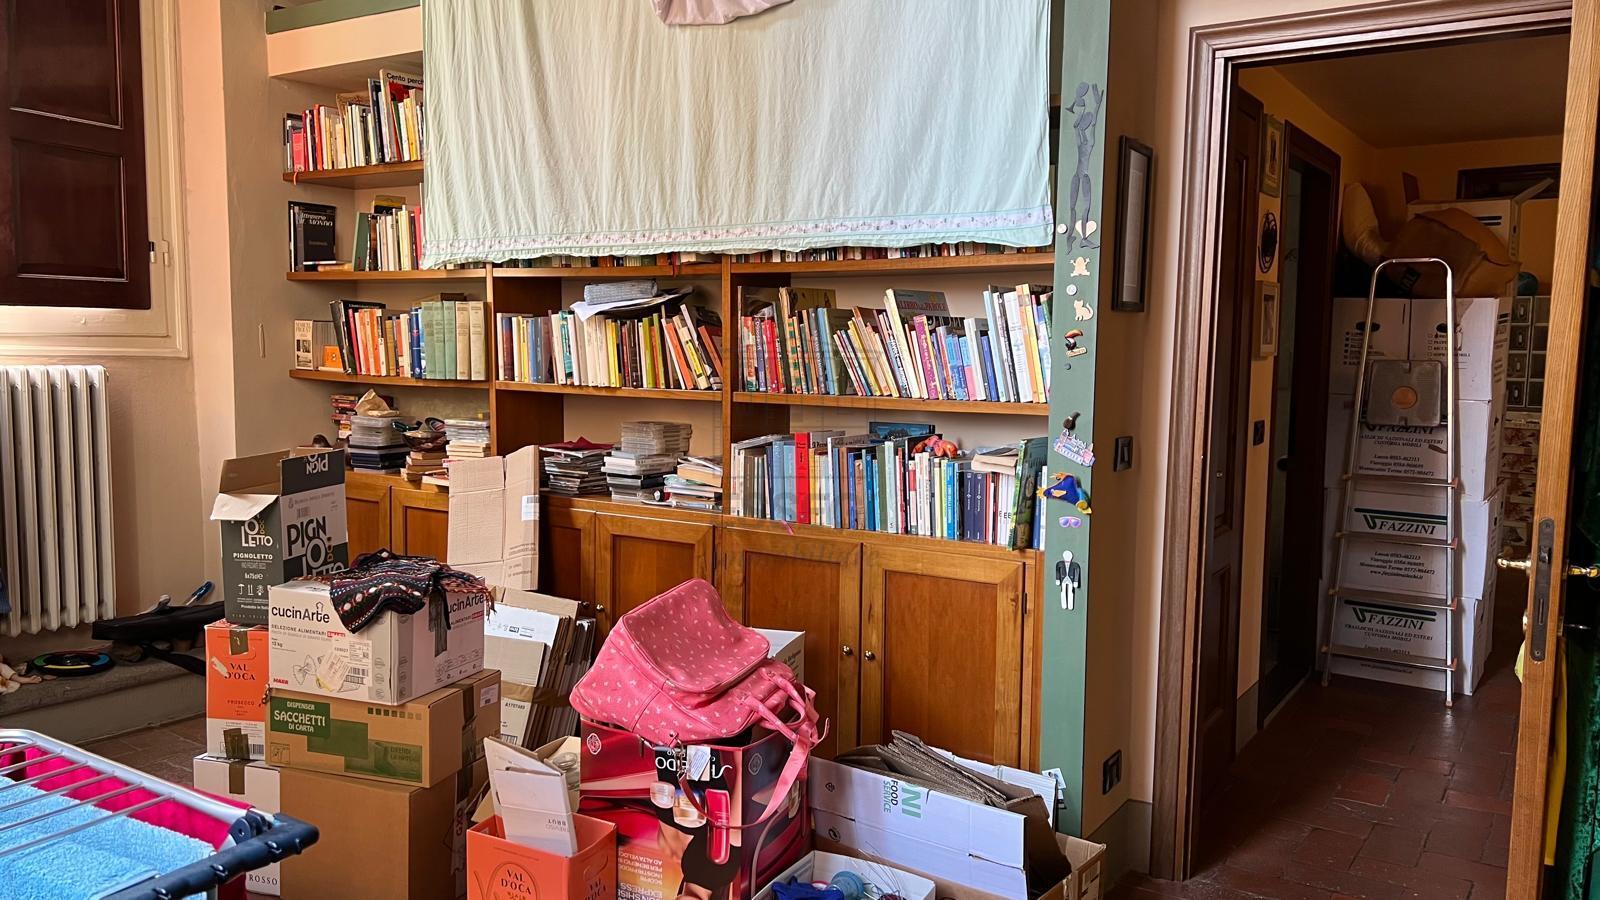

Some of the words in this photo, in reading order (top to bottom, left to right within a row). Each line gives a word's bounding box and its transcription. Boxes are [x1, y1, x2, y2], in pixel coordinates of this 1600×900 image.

[386, 72, 405, 82] Cento
[1379, 520, 1436, 535] FAZZINI
[241, 525, 273, 547] LETTO
[287, 516, 327, 557] PIGN
[232, 552, 273, 560] PIGNOLETTO
[449, 593, 484, 614] ucinArte
[271, 606, 330, 623] cucinArte
[1368, 614, 1425, 630] FAZZINI
[271, 623, 297, 632] SELEZIONE
[297, 628, 327, 637] ALIMENTARI
[230, 663, 248, 671] VAL
[286, 701, 315, 711] DISPENSER
[273, 710, 326, 727] SACCHETTI
[288, 723, 297, 731] DI
[295, 724, 315, 733] CARTA
[883, 780, 892, 813] SERVICE
[890, 779, 899, 806] FOOD
[249, 873, 278, 886] ROSSO
[507, 869, 524, 882] VAL
[501, 878, 531, 895] D'OCA
[619, 882, 663, 899] EXPRESS
